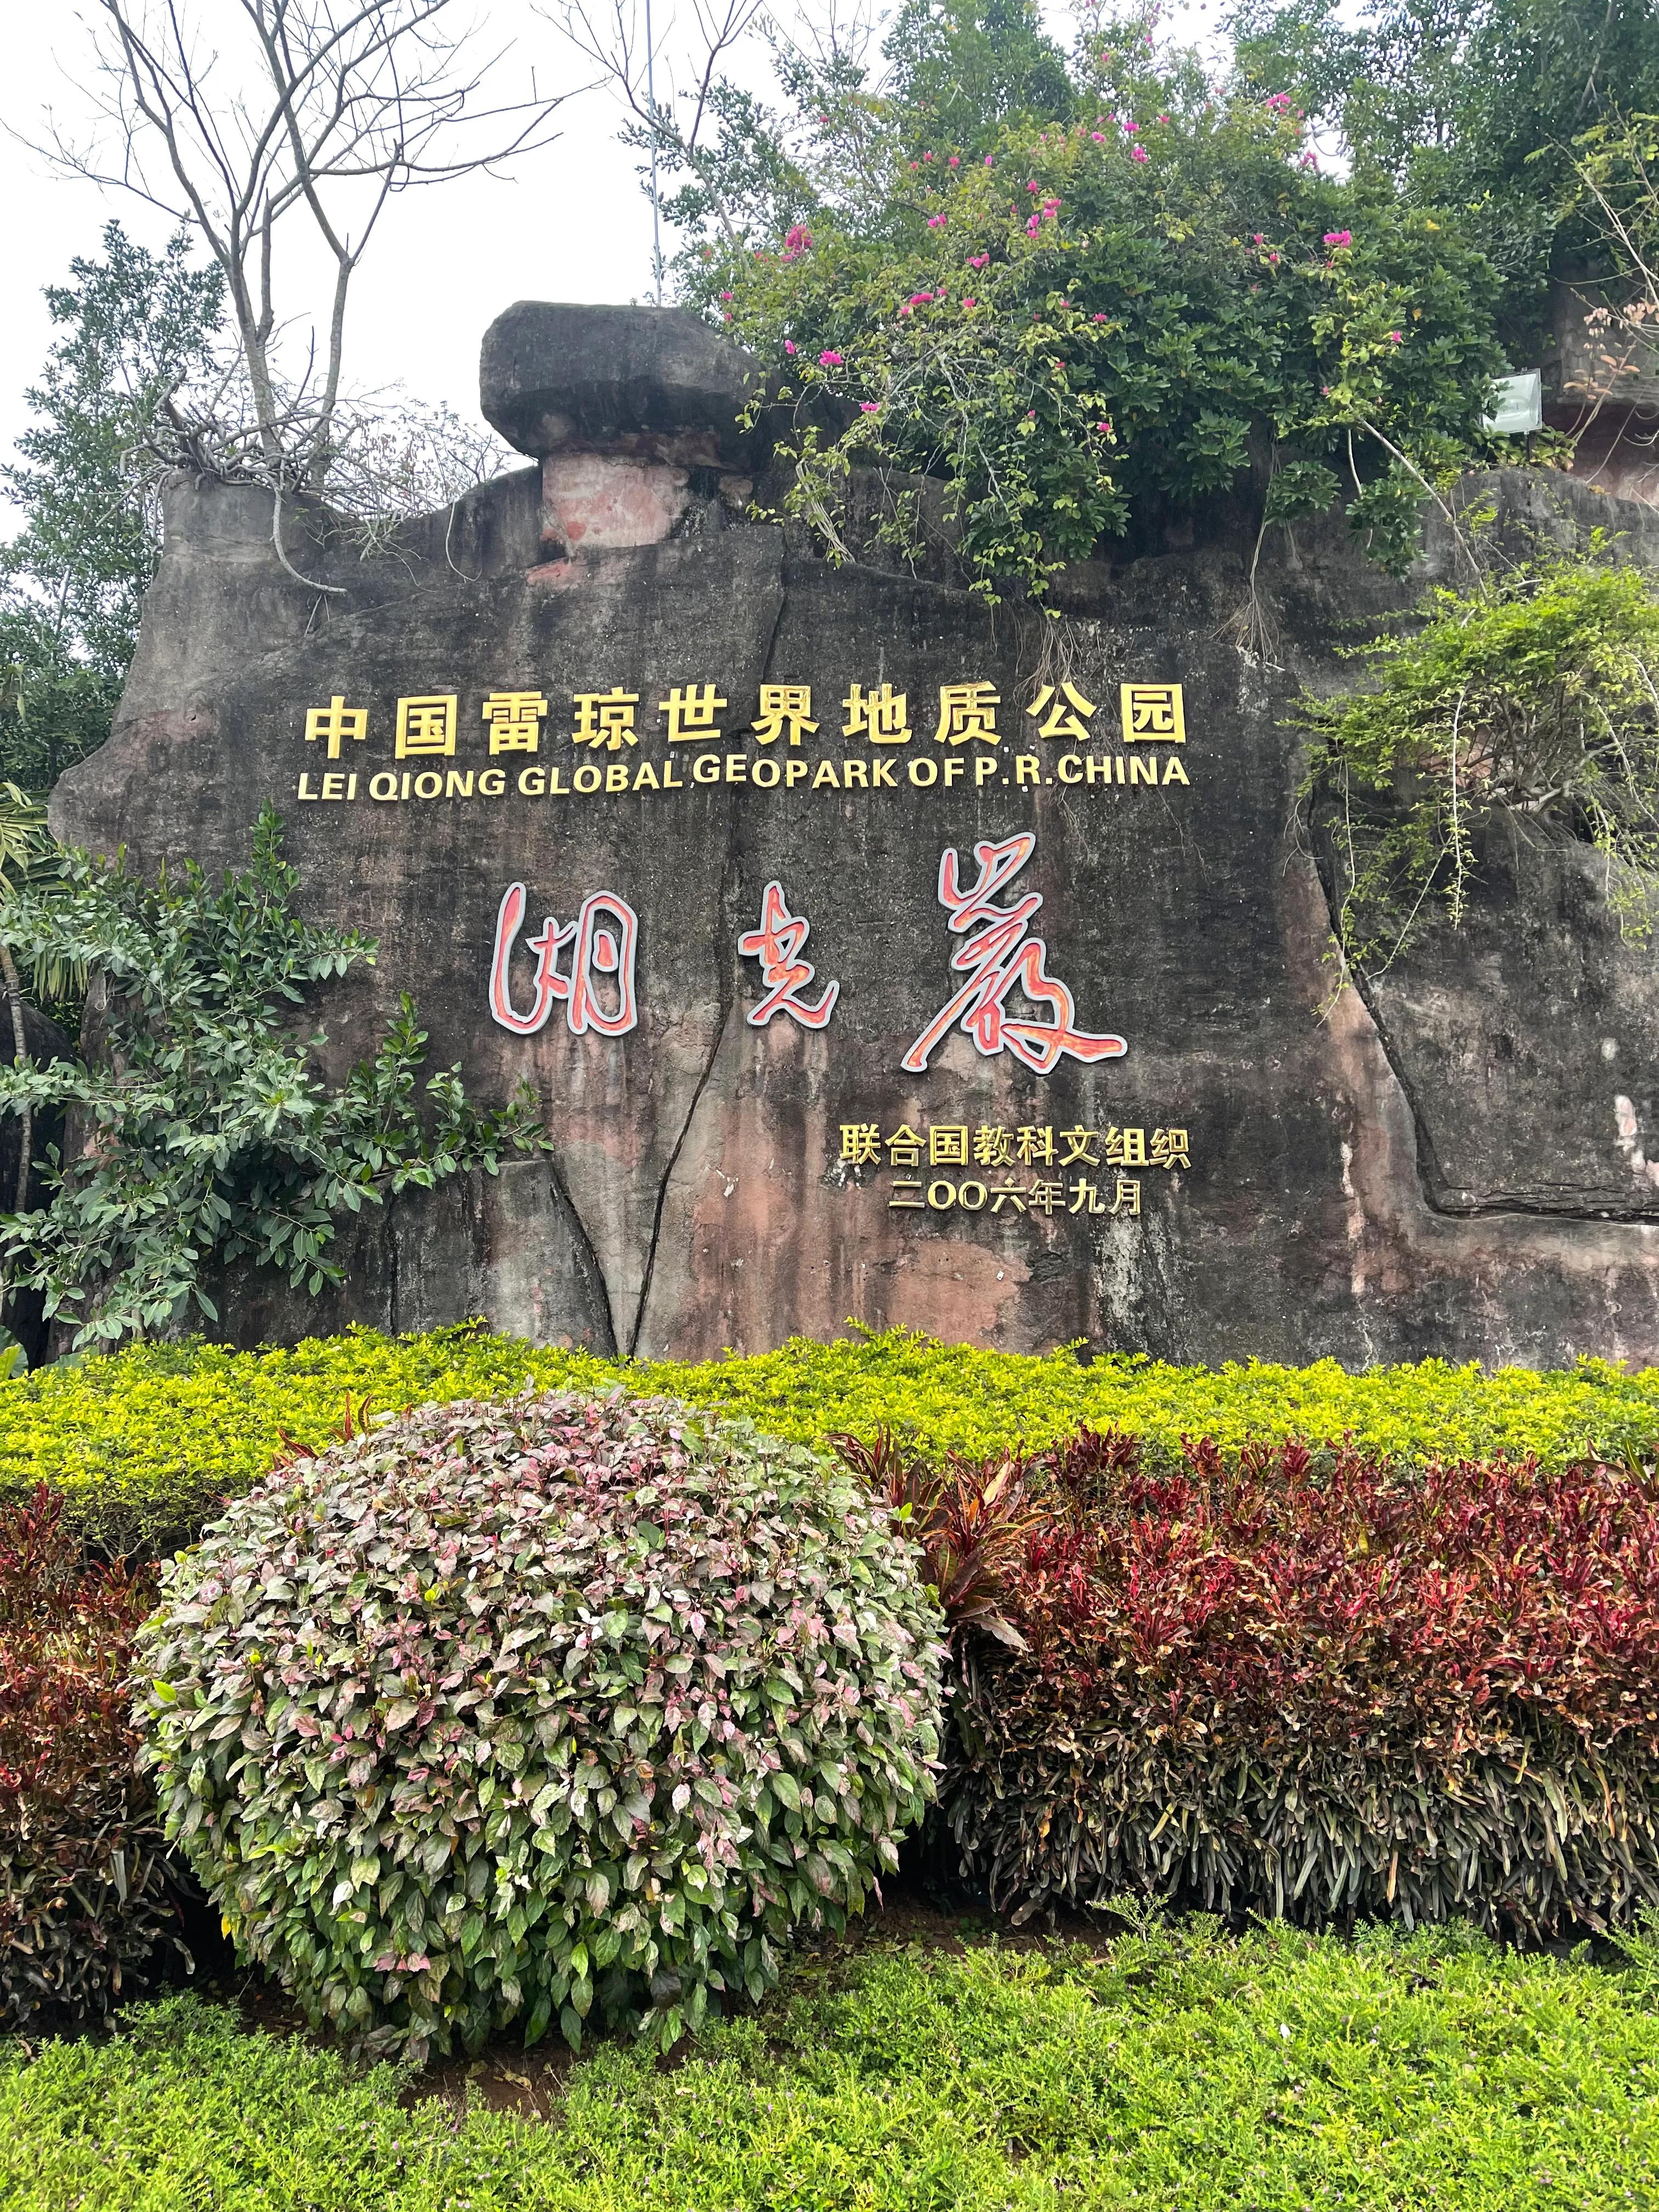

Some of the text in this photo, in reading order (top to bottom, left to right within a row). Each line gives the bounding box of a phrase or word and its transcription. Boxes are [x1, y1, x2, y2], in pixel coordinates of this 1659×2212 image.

[304, 682, 1187, 759] 中国雷琼世界地质公园
[298, 772, 356, 800] LEI
[369, 768, 506, 801] QIONG
[518, 760, 683, 796] GLOBAL
[693, 753, 898, 789] GEOPARK
[909, 757, 964, 787] OF
[839, 1124, 1192, 1169] 联合国教科文组织
